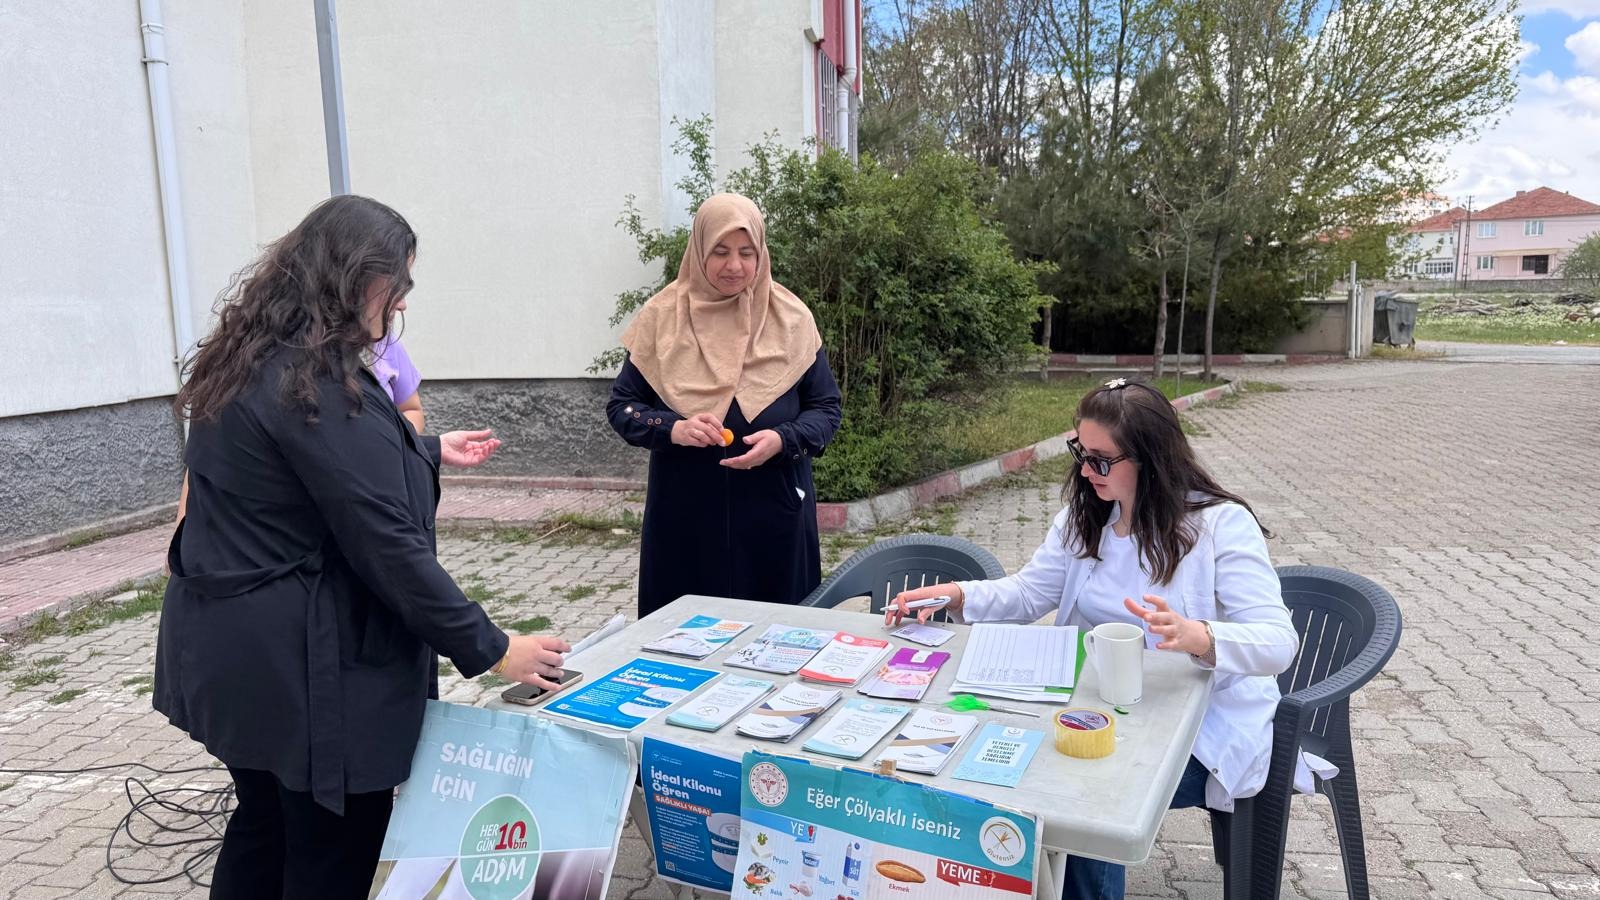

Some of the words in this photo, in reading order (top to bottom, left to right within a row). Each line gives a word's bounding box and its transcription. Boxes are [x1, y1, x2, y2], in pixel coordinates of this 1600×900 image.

[440, 741, 534, 779] SAĞLIĞIN
[431, 768, 476, 802] İÇİN
[650, 765, 681, 786] İdeal
[682, 776, 722, 797] Kilonu
[652, 779, 690, 800] Öğren
[655, 794, 687, 810] SAĞLIKLI
[807, 787, 841, 809] Eğer
[844, 796, 906, 827] Çölyaklı
[911, 813, 961, 840] iseniz
[479, 823, 499, 838] HER
[495, 820, 527, 851] 10
[476, 837, 495, 852] GÜN
[513, 838, 528, 850] bin
[986, 847, 1015, 862] Glutensiz
[940, 860, 981, 884] YEME
[888, 883, 911, 893] Ekmek
